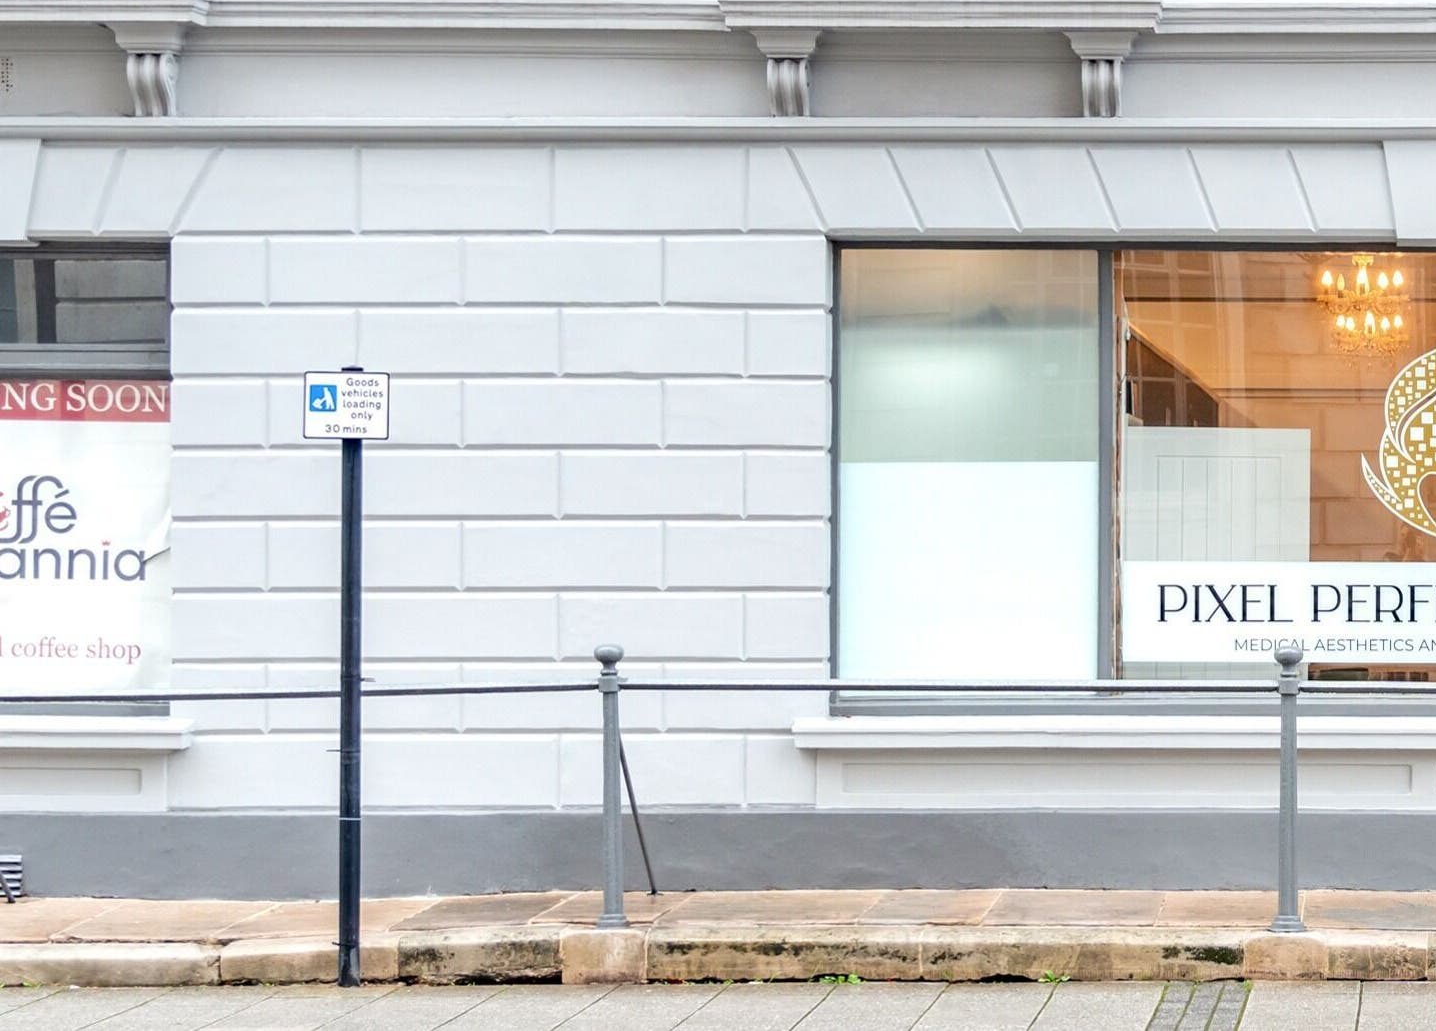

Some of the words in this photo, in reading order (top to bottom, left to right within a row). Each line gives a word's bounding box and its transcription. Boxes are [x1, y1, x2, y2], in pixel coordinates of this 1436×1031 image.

[346, 377, 379, 387] Goods
[66, 384, 169, 412] SOON
[341, 389, 383, 398] vehicles
[343, 400, 381, 410] loading
[351, 411, 373, 420] only
[325, 424, 340, 433] 30
[342, 425, 367, 433] mins
[1157, 584, 1294, 623] PIXEL
[1313, 638, 1414, 652] AESTHETICS
[11, 636, 78, 658] coffee
[86, 638, 141, 665] shop
